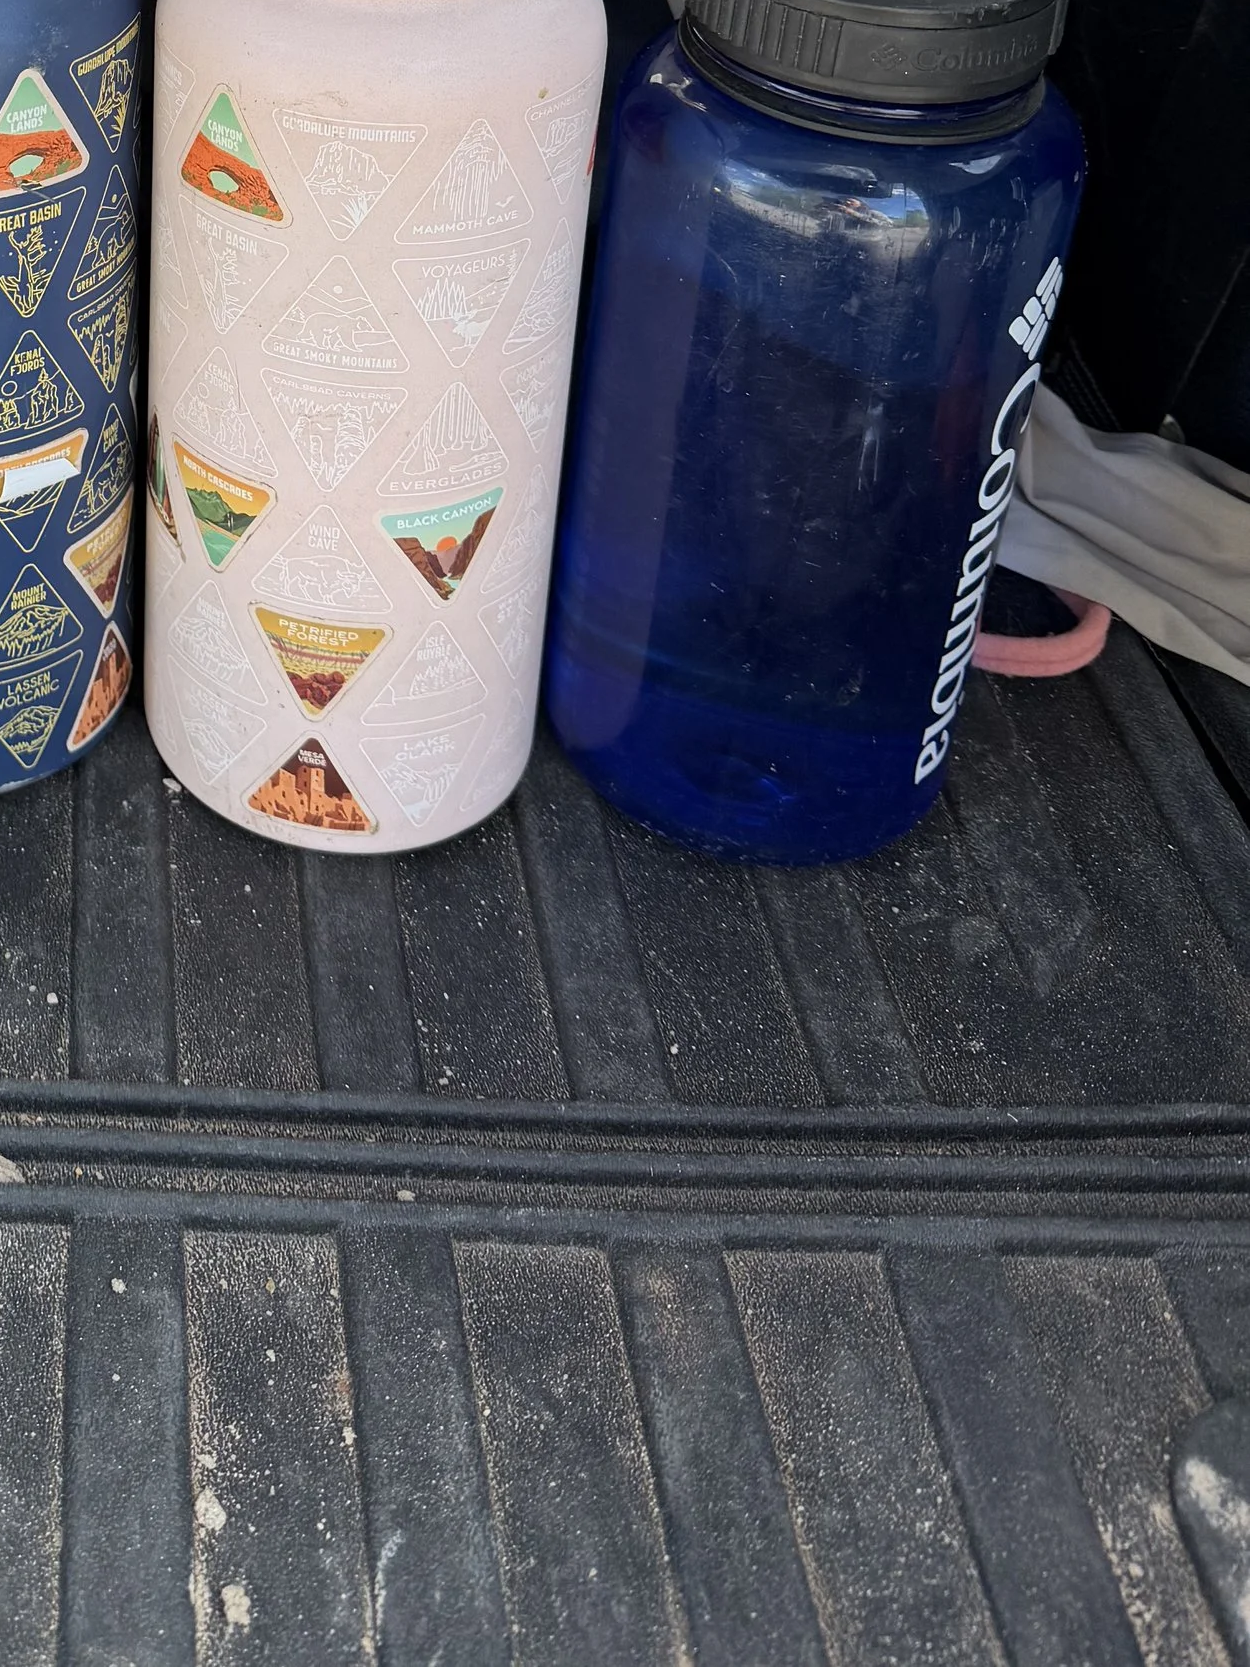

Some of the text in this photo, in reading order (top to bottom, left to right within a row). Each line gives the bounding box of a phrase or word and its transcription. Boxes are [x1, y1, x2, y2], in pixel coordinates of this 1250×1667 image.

[6, 104, 48, 124] CANYON
[10, 116, 44, 133] LANDS
[207, 119, 243, 143] CANYON
[282, 116, 416, 143] GUADALUPE MOUNTAINS
[211, 133, 239, 152] LANDS
[29, 201, 62, 226] BASIN
[413, 210, 518, 235] MAMMOTH CAVE
[196, 214, 258, 256] GREAT BASIN
[422, 254, 505, 278] VOYAGEURS
[76, 274, 96, 293] GREAT
[14, 346, 42, 364] KENAI
[273, 341, 398, 369] GREAT SMOKY MOUNTAINS
[10, 357, 45, 376] FJORDS
[273, 376, 391, 400] CARLSBAD CAVERNS
[103, 432, 118, 453] CAVE
[183, 454, 254, 502] NORTH CASCADES
[389, 462, 502, 491] EVERGLADES
[397, 497, 492, 529] BLACK CANYON
[308, 524, 340, 540] WIND
[308, 536, 339, 551] CAVE
[914, 362, 1042, 785] Columbia
[12, 583, 46, 601] MOUNT
[11, 593, 47, 612] RAINIER
[278, 618, 359, 641] PETRIFIED
[287, 628, 350, 647] FOREST
[425, 635, 445, 648] ISLE
[7, 671, 51, 696] LASSEN
[395, 742, 455, 762] CLARK
[403, 734, 450, 751] LAKE
[297, 754, 327, 768] VERDE
[299, 749, 324, 761] MESA
